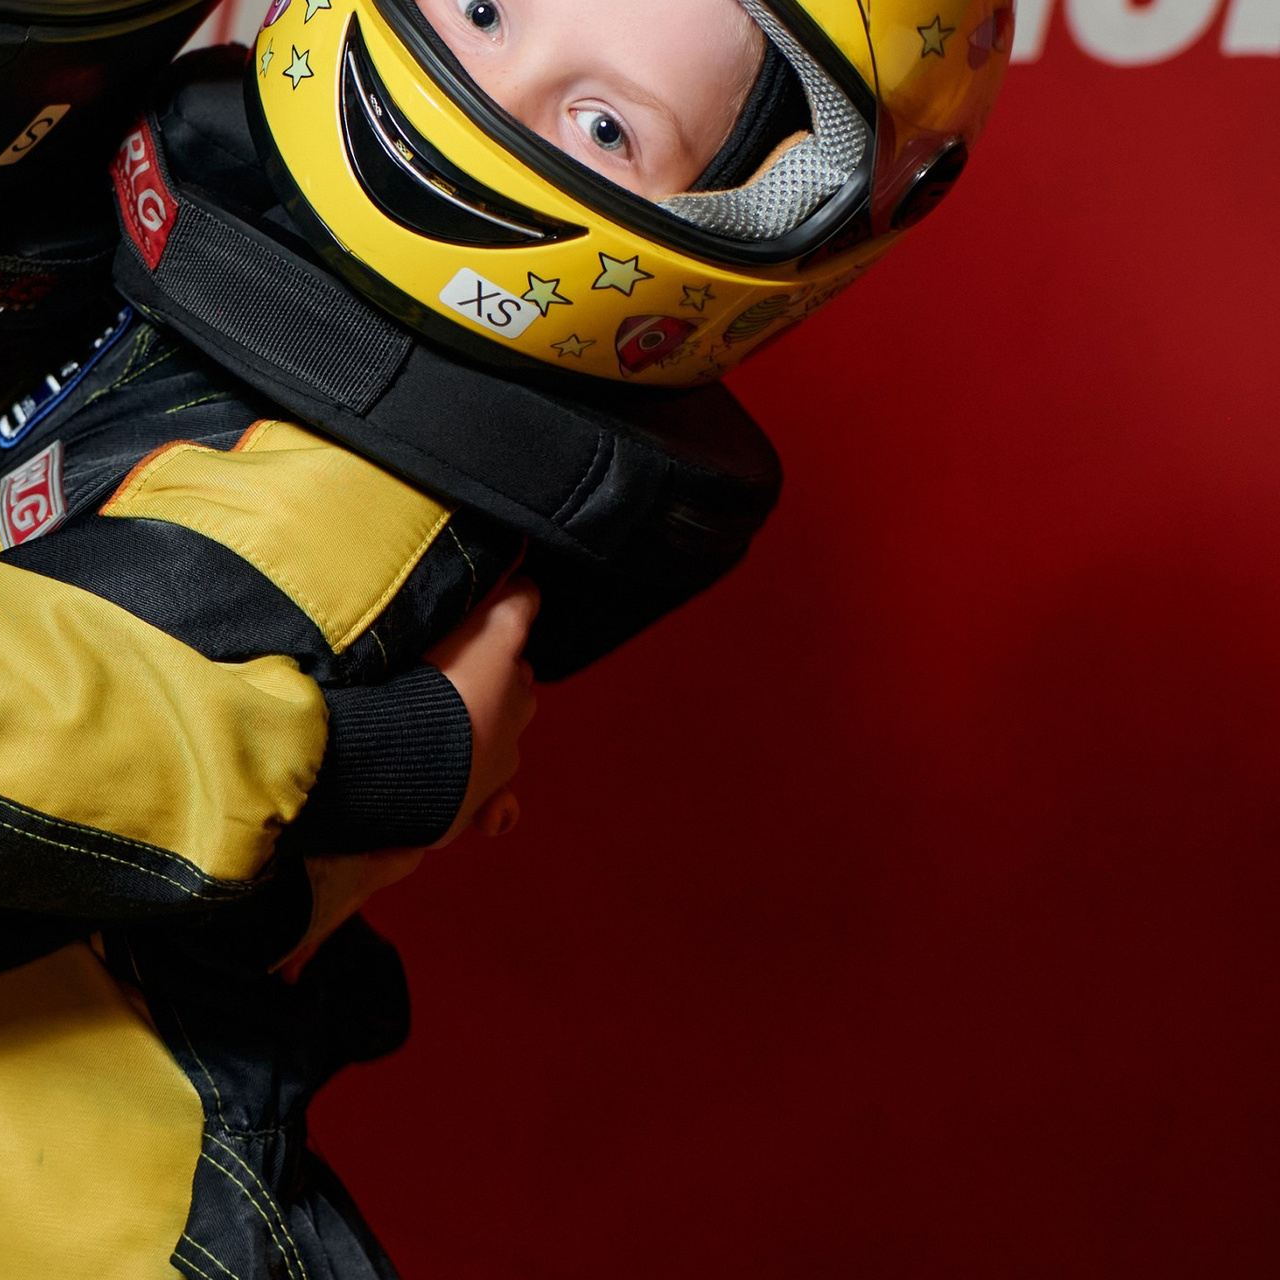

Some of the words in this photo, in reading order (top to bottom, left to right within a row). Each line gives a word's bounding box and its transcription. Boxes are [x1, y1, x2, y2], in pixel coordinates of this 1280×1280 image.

[11, 117, 53, 152] S
[119, 129, 167, 232] RLG
[456, 279, 522, 328] XS
